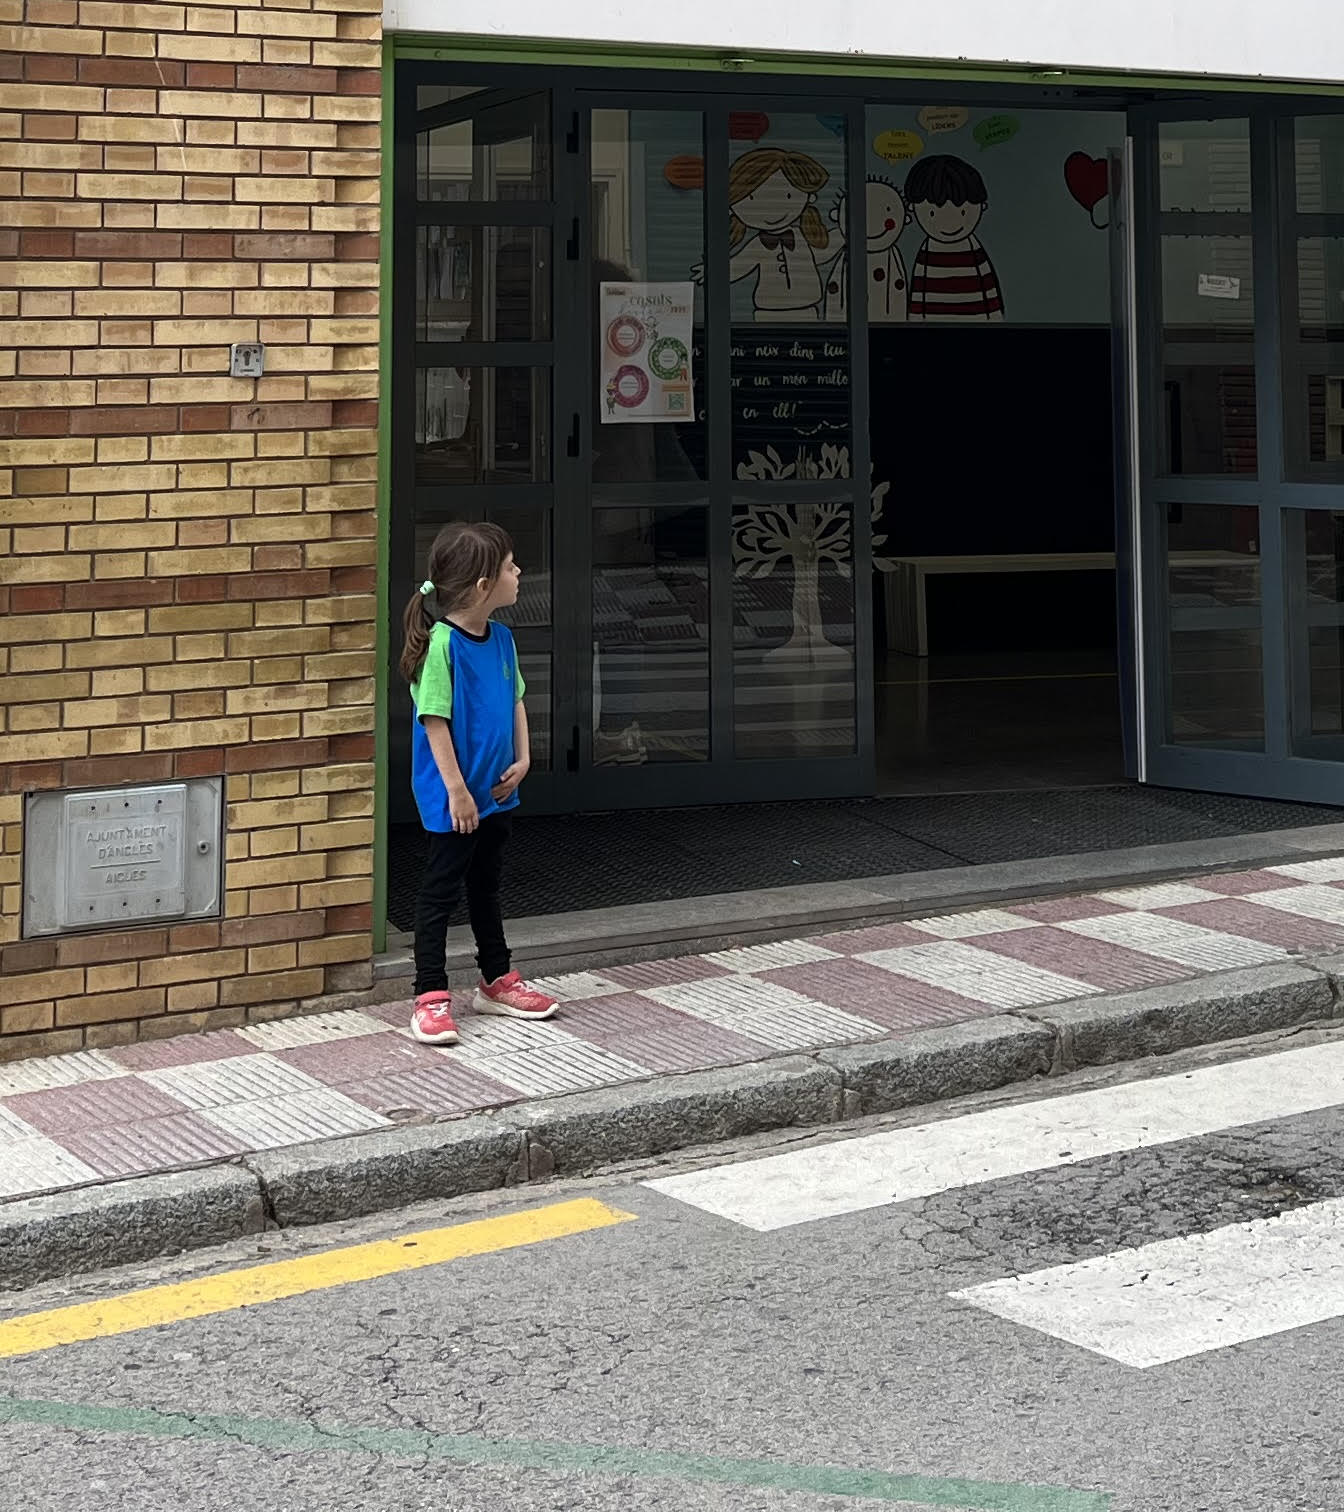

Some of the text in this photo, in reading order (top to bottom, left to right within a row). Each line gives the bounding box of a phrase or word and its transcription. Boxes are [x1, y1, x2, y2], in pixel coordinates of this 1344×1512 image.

[629, 293, 673, 306] casals
[755, 343, 780, 357] neix
[789, 340, 816, 361] dins
[754, 375, 772, 386] un
[817, 368, 849, 387] millo
[742, 407, 760, 420] en
